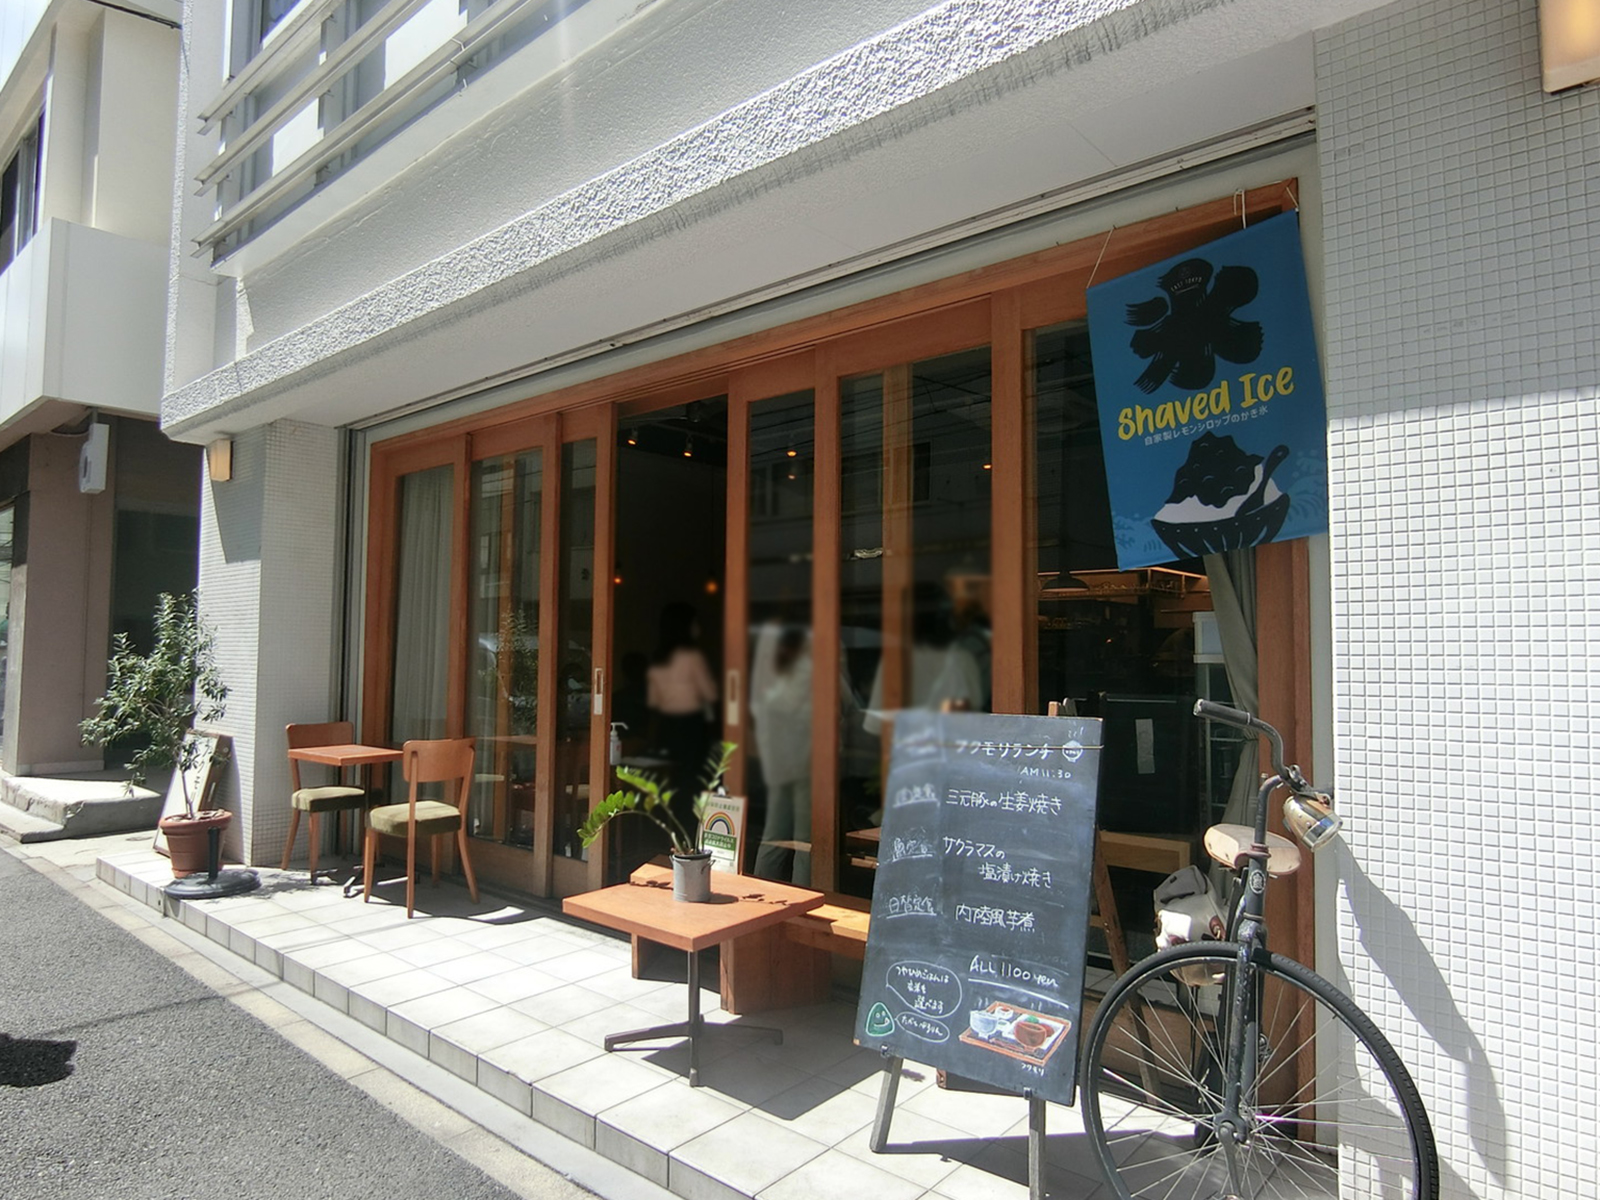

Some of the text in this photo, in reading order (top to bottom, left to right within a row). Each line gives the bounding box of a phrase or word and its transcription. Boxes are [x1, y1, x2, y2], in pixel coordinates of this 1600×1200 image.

[1238, 366, 1295, 408] Ice
[1144, 405, 1268, 446] 自家製レモンシロップのかき氷
[946, 788, 1062, 816] 三元豚の生姜焼き
[942, 836, 1006, 859] サクラマスの
[978, 862, 1052, 889] 塩漬け焼き
[969, 955, 996, 974] ALL
[1001, 961, 1031, 980] 1100
